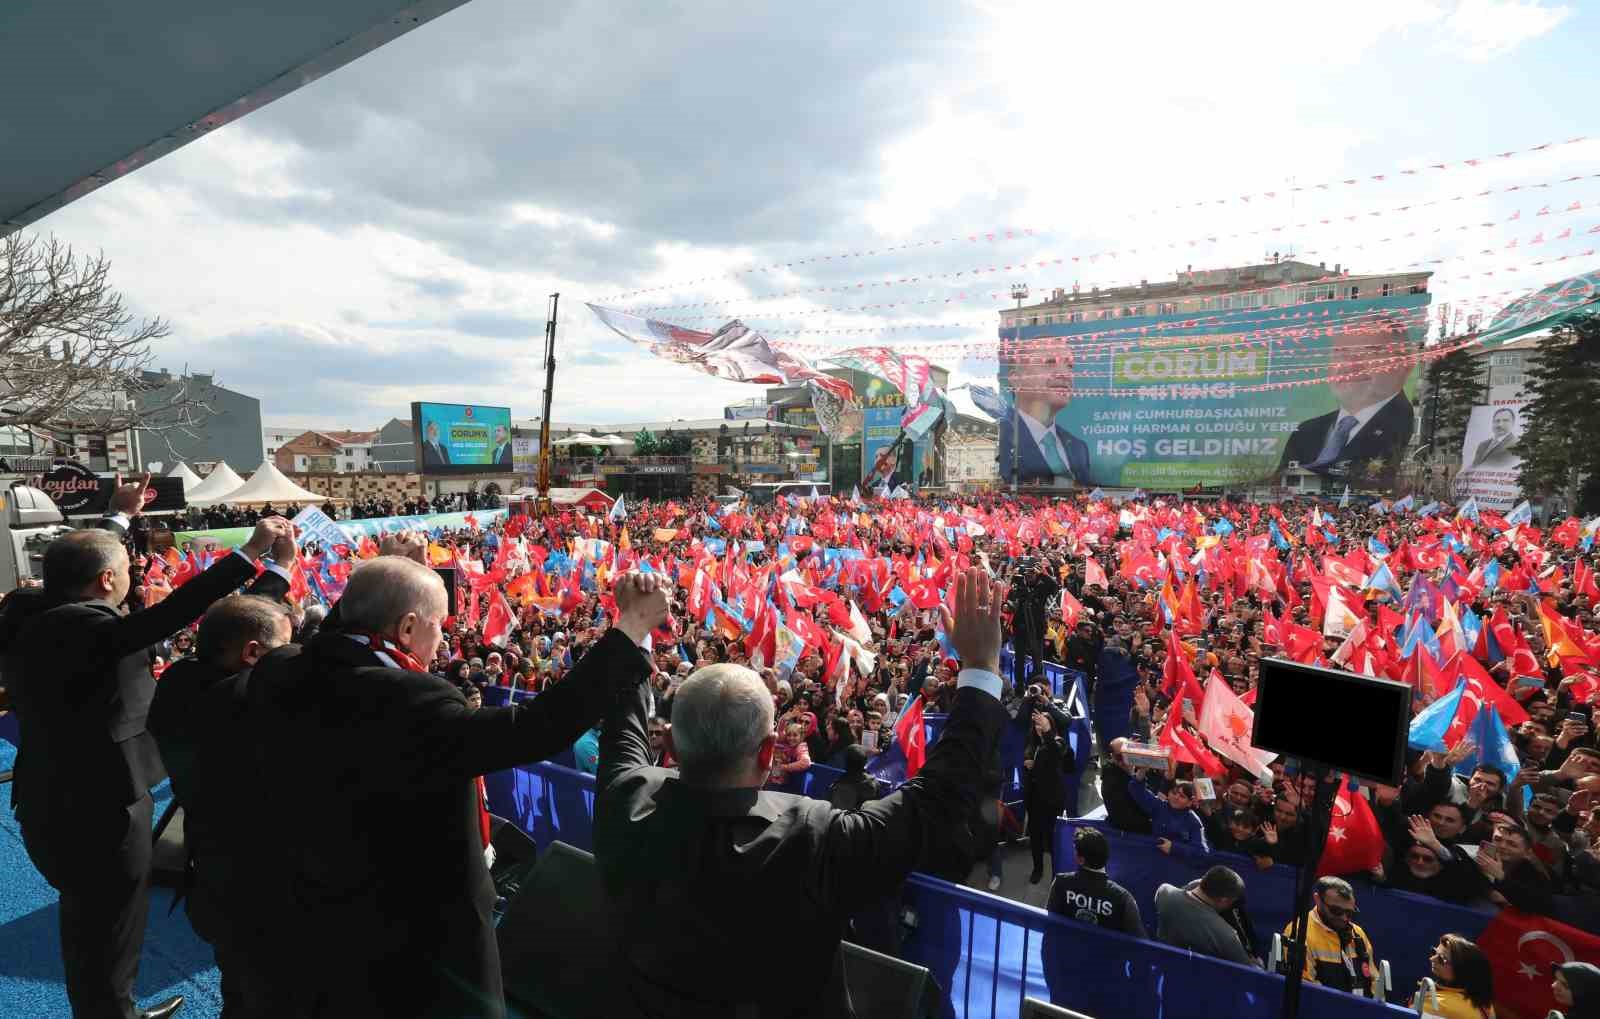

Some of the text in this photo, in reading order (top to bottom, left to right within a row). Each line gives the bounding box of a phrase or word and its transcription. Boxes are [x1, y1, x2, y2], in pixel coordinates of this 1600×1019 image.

[1093, 409, 1132, 421] SAYIN
[1133, 423, 1190, 433] HARMAN
[1194, 421, 1256, 432] OLDUĞU
[1261, 421, 1300, 432] YERE
[1096, 437, 1279, 458] HOŞ GELDİNİZ
